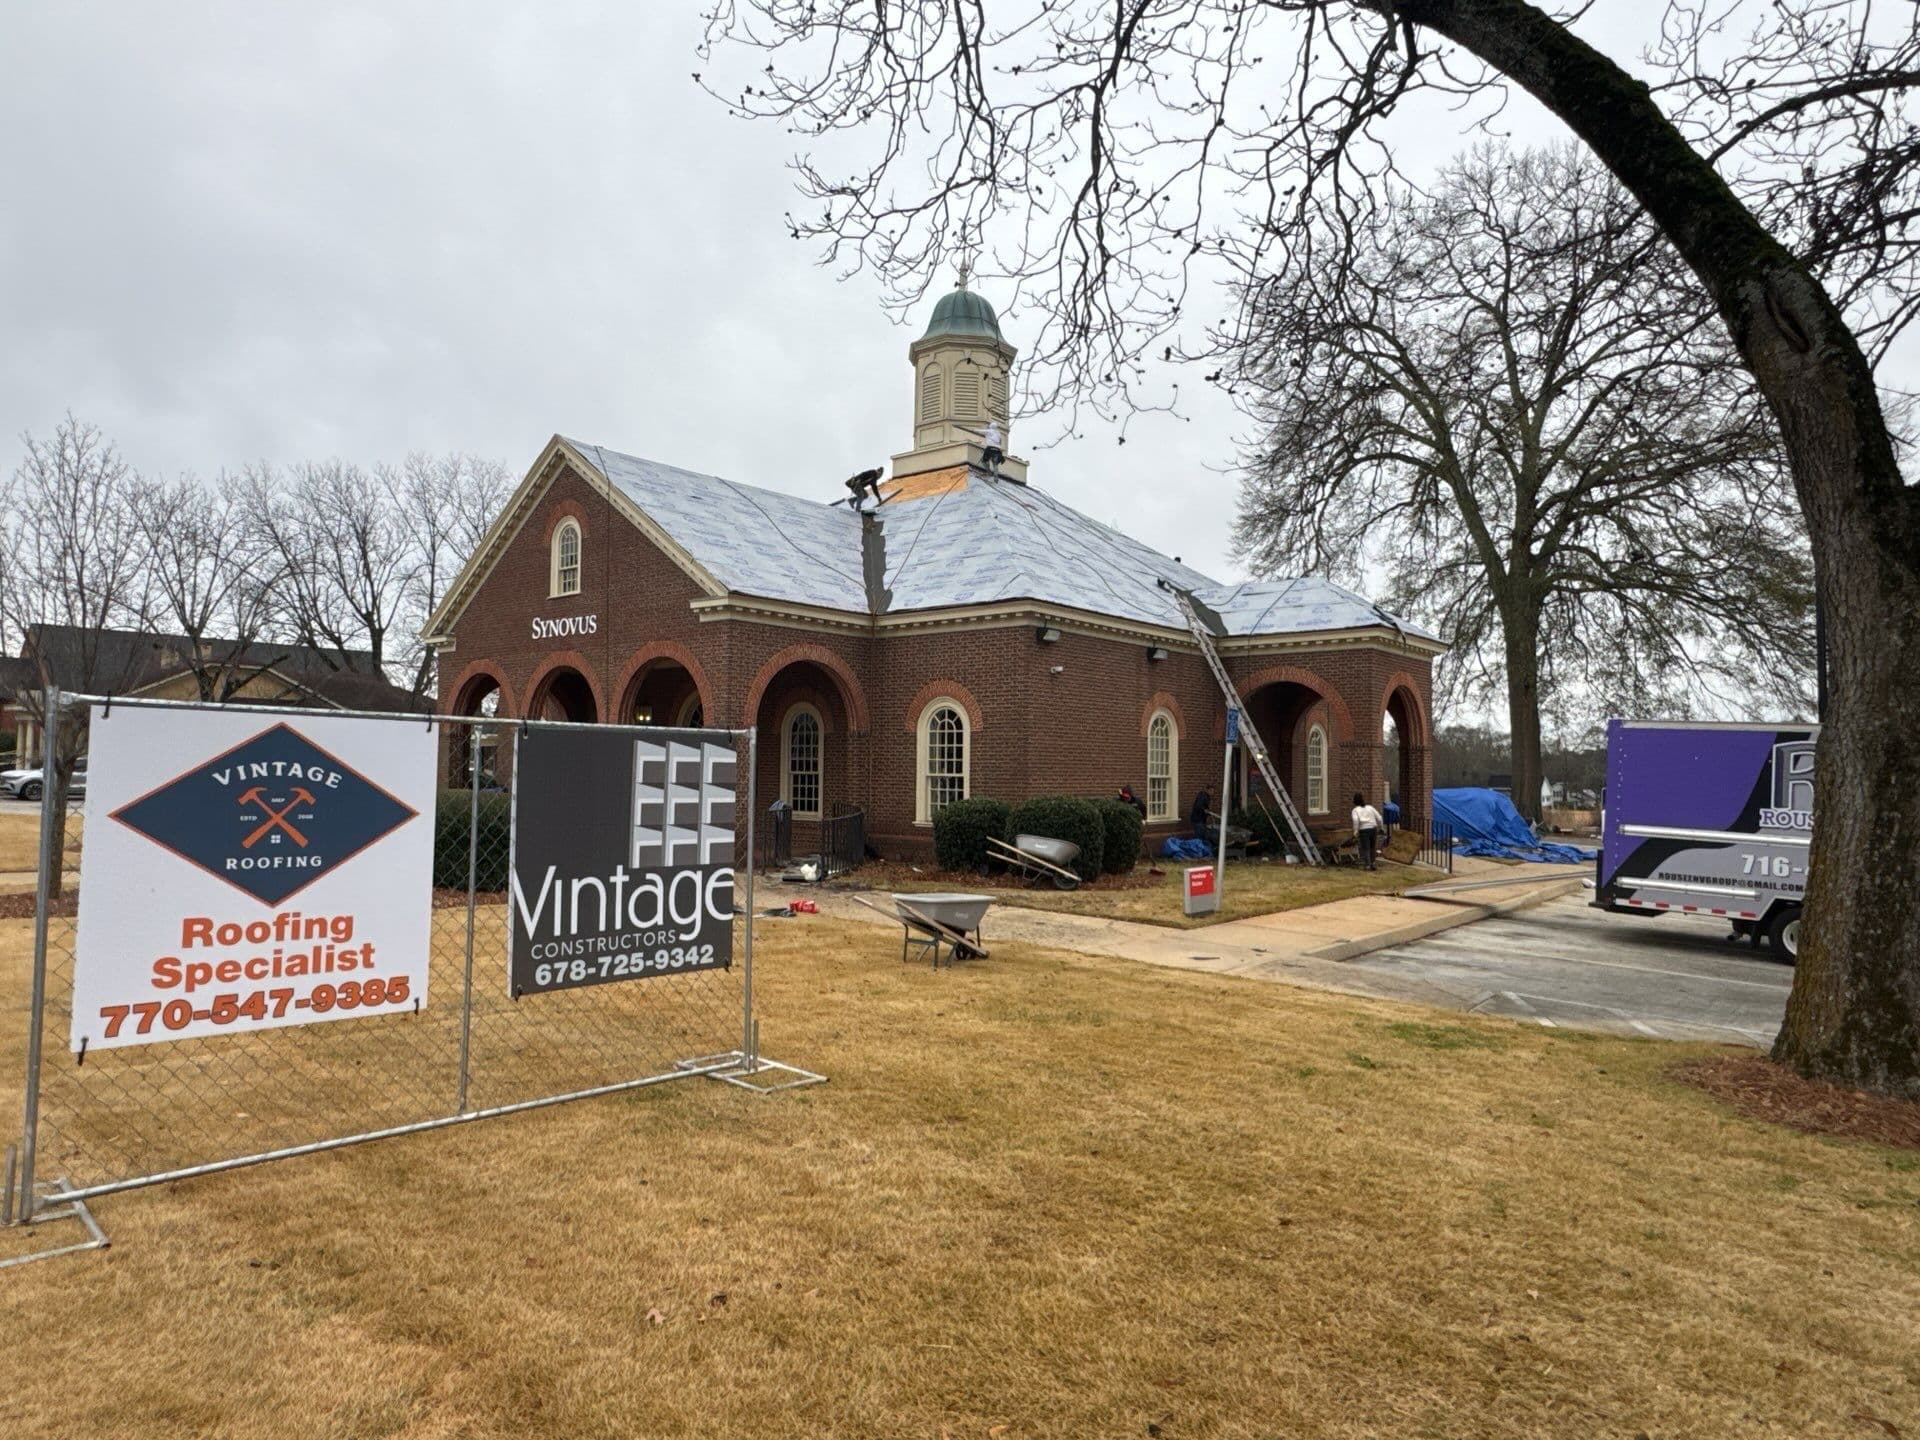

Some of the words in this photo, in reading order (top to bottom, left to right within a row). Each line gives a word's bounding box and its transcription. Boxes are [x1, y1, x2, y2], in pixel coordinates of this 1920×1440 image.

[532, 615, 597, 639] SYNOVUS
[211, 761, 343, 789] VINTAGE
[225, 856, 322, 870] ROOFING
[513, 865, 734, 942] Vintage
[181, 912, 354, 949] Roofing
[531, 929, 676, 960] CONSTRUCTORS
[151, 942, 375, 993] Specialist
[535, 944, 714, 986] 678-725-9342
[100, 975, 410, 1038] 770-547-9385
